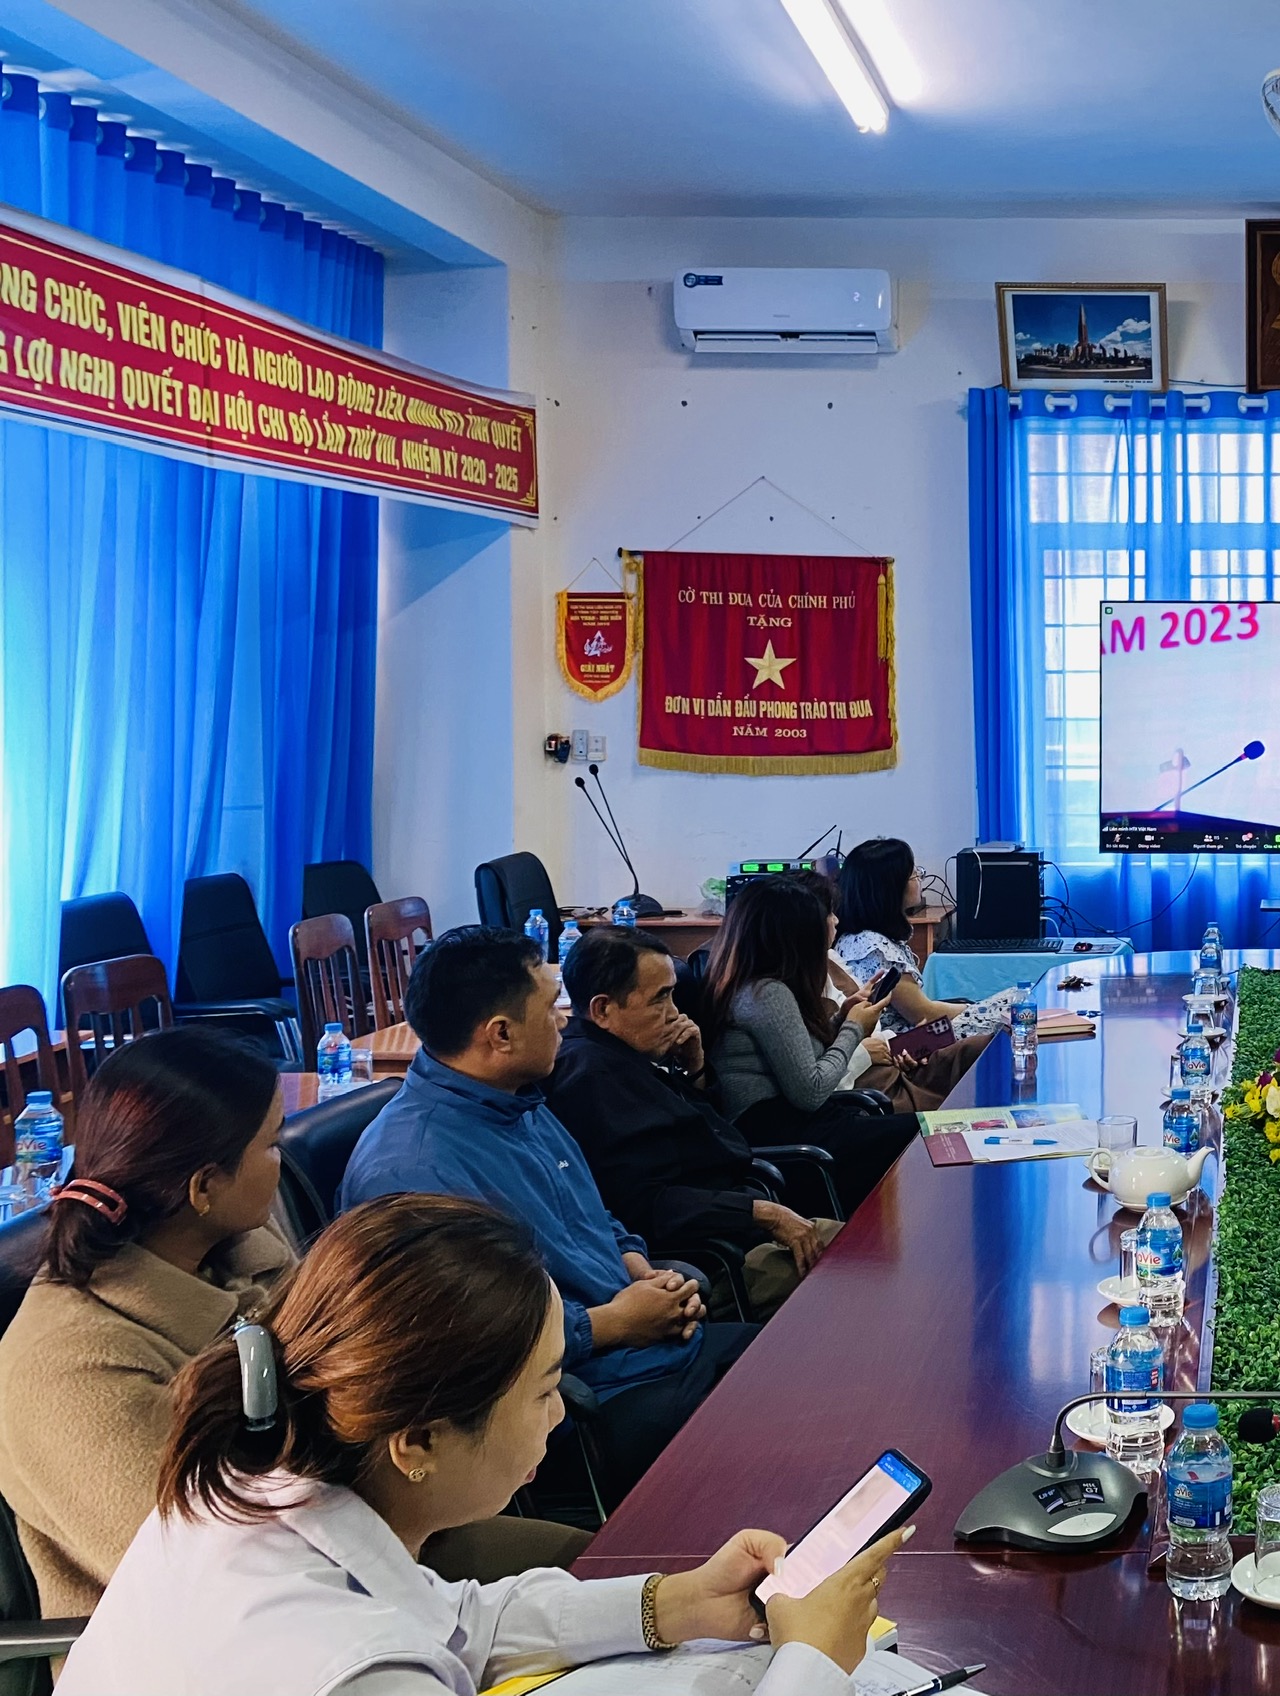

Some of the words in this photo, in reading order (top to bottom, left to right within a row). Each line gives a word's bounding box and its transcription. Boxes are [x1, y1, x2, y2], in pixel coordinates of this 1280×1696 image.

[0, 263, 37, 314] NG
[44, 277, 113, 342] CHỨC,
[117, 301, 166, 353] VIÊN
[171, 320, 221, 369] CHỨC
[225, 334, 249, 378] VÀ
[252, 345, 303, 394] NGƯỜI
[307, 364, 333, 402] LAO
[338, 372, 375, 416] ĐỘNG
[376, 385, 405, 423] LIÊN
[491, 416, 522, 452] QUYẾT
[14, 335, 54, 391] LỢI
[60, 348, 115, 409] NGHỊ
[121, 365, 183, 417] QUYẾT
[189, 384, 219, 433] ĐẠI
[225, 391, 255, 439] HỘI
[257, 404, 288, 442] CHI
[289, 408, 314, 454] BỘ
[374, 434, 400, 470] VIII,
[402, 438, 442, 478] NHIỆM
[461, 454, 486, 486] 2020
[496, 464, 519, 493] 2025
[678, 586, 695, 603] CỜ
[700, 593, 722, 605] THI
[729, 593, 752, 607] ĐUA
[759, 588, 783, 608] CỦA
[789, 590, 827, 609] CHÍNH
[832, 591, 855, 609] PHỦ
[747, 614, 792, 629] TẶNG
[1159, 604, 1260, 649] 2023
[665, 695, 689, 714] ĐƠN
[692, 700, 705, 720] VỊ
[708, 692, 732, 717] DẪN
[734, 694, 757, 718] ĐẦU
[759, 701, 797, 719] PHONG
[800, 697, 828, 720] TRÀO
[829, 701, 847, 719] THI
[849, 699, 873, 718] ĐUA
[732, 724, 768, 738] NĂM
[775, 729, 807, 738] 2003
[17, 1140, 47, 1151] aVie
[1136, 1252, 1160, 1265] aVie
